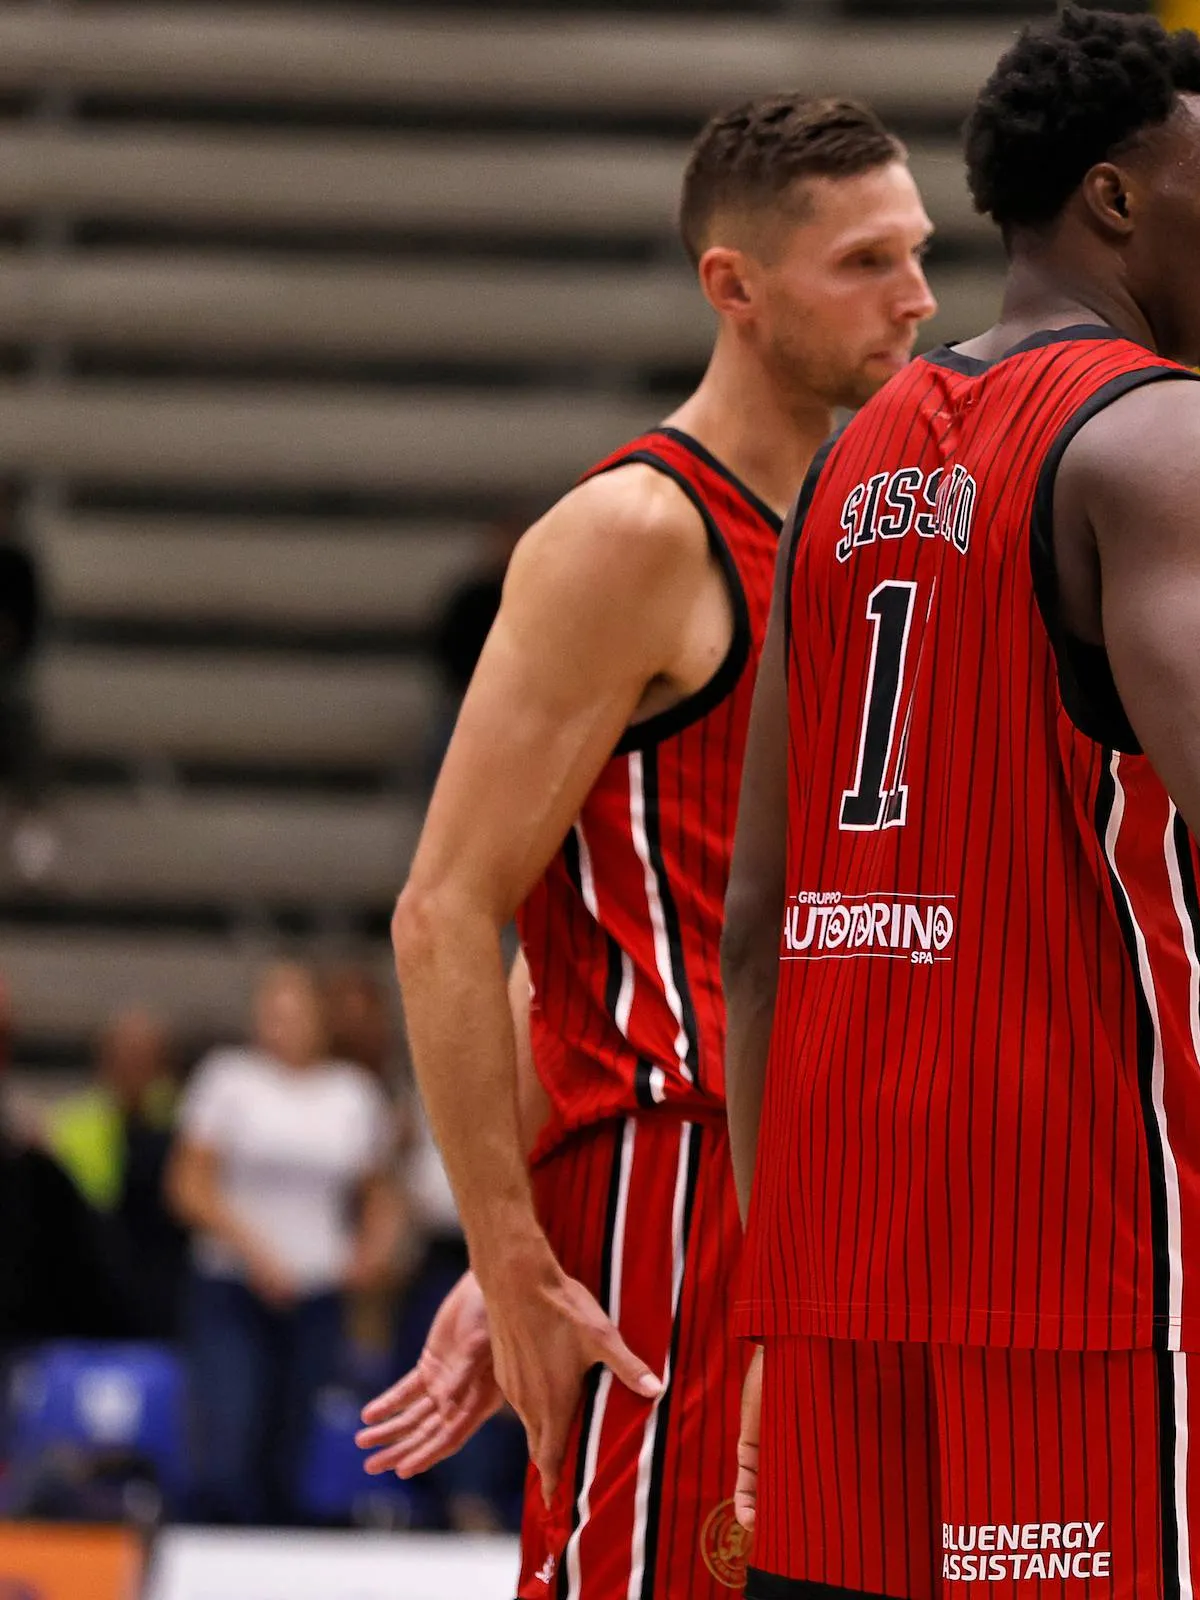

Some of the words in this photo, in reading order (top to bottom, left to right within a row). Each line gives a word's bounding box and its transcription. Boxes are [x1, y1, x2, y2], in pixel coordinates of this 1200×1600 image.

[836, 464, 976, 563] SISSO
[798, 891, 841, 904] GRUPPO
[911, 951, 933, 964] SPA
[942, 1522, 1104, 1551] BLUENERGY
[942, 1552, 1111, 1581] ASSISTANCE
